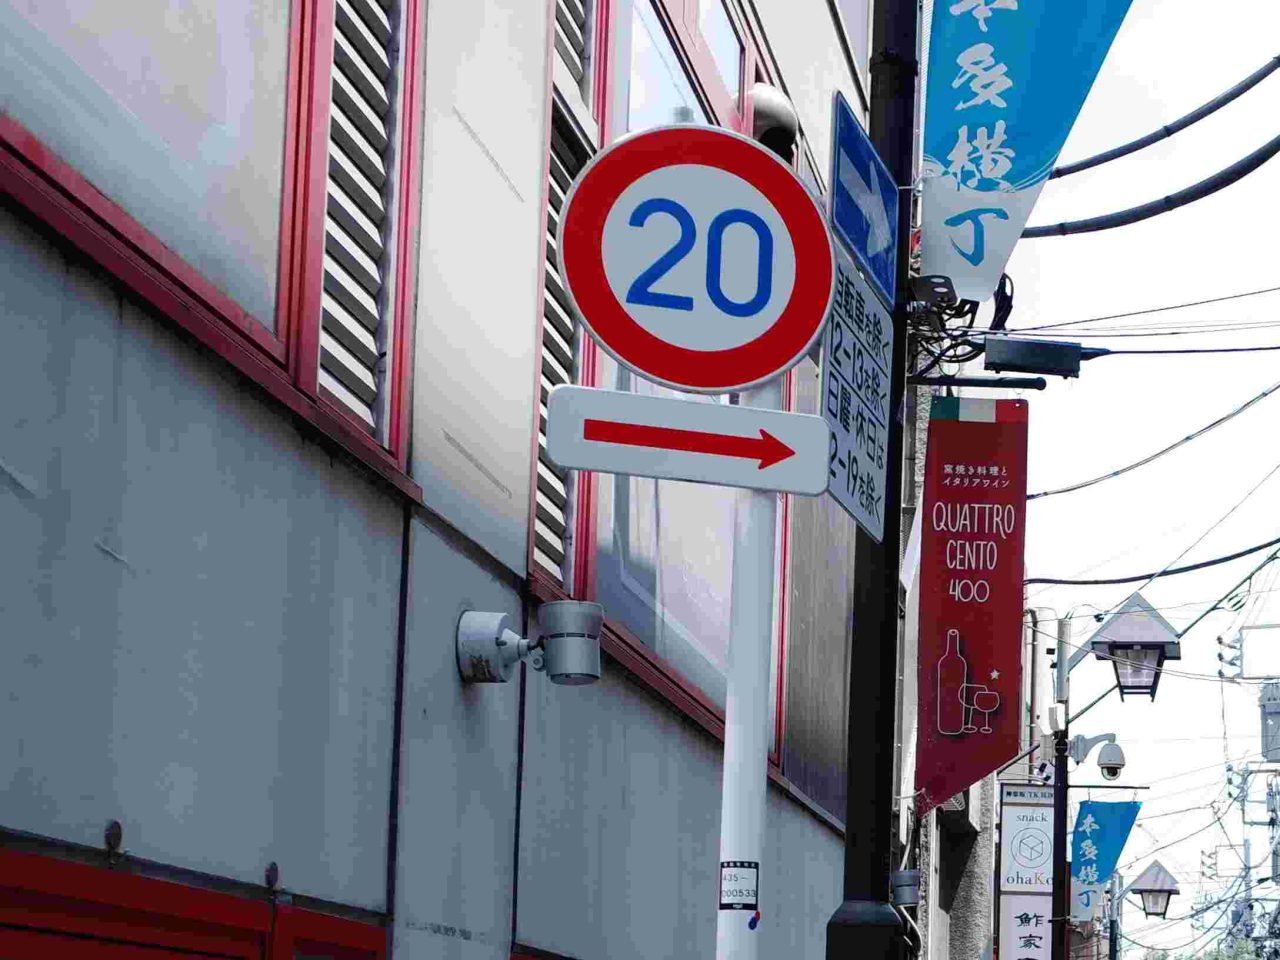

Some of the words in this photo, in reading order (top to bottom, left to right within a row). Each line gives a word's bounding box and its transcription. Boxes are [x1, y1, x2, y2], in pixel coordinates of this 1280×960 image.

[626, 197, 773, 318] 20
[829, 431, 882, 524] 2-19を除く
[942, 477, 1009, 488] イタリアワイン
[932, 501, 1015, 538] QUATTRO
[946, 540, 997, 570] CENTO
[949, 579, 989, 603] 400
[1016, 812, 1048, 822] snack
[1078, 813, 1100, 908] 本多横丁
